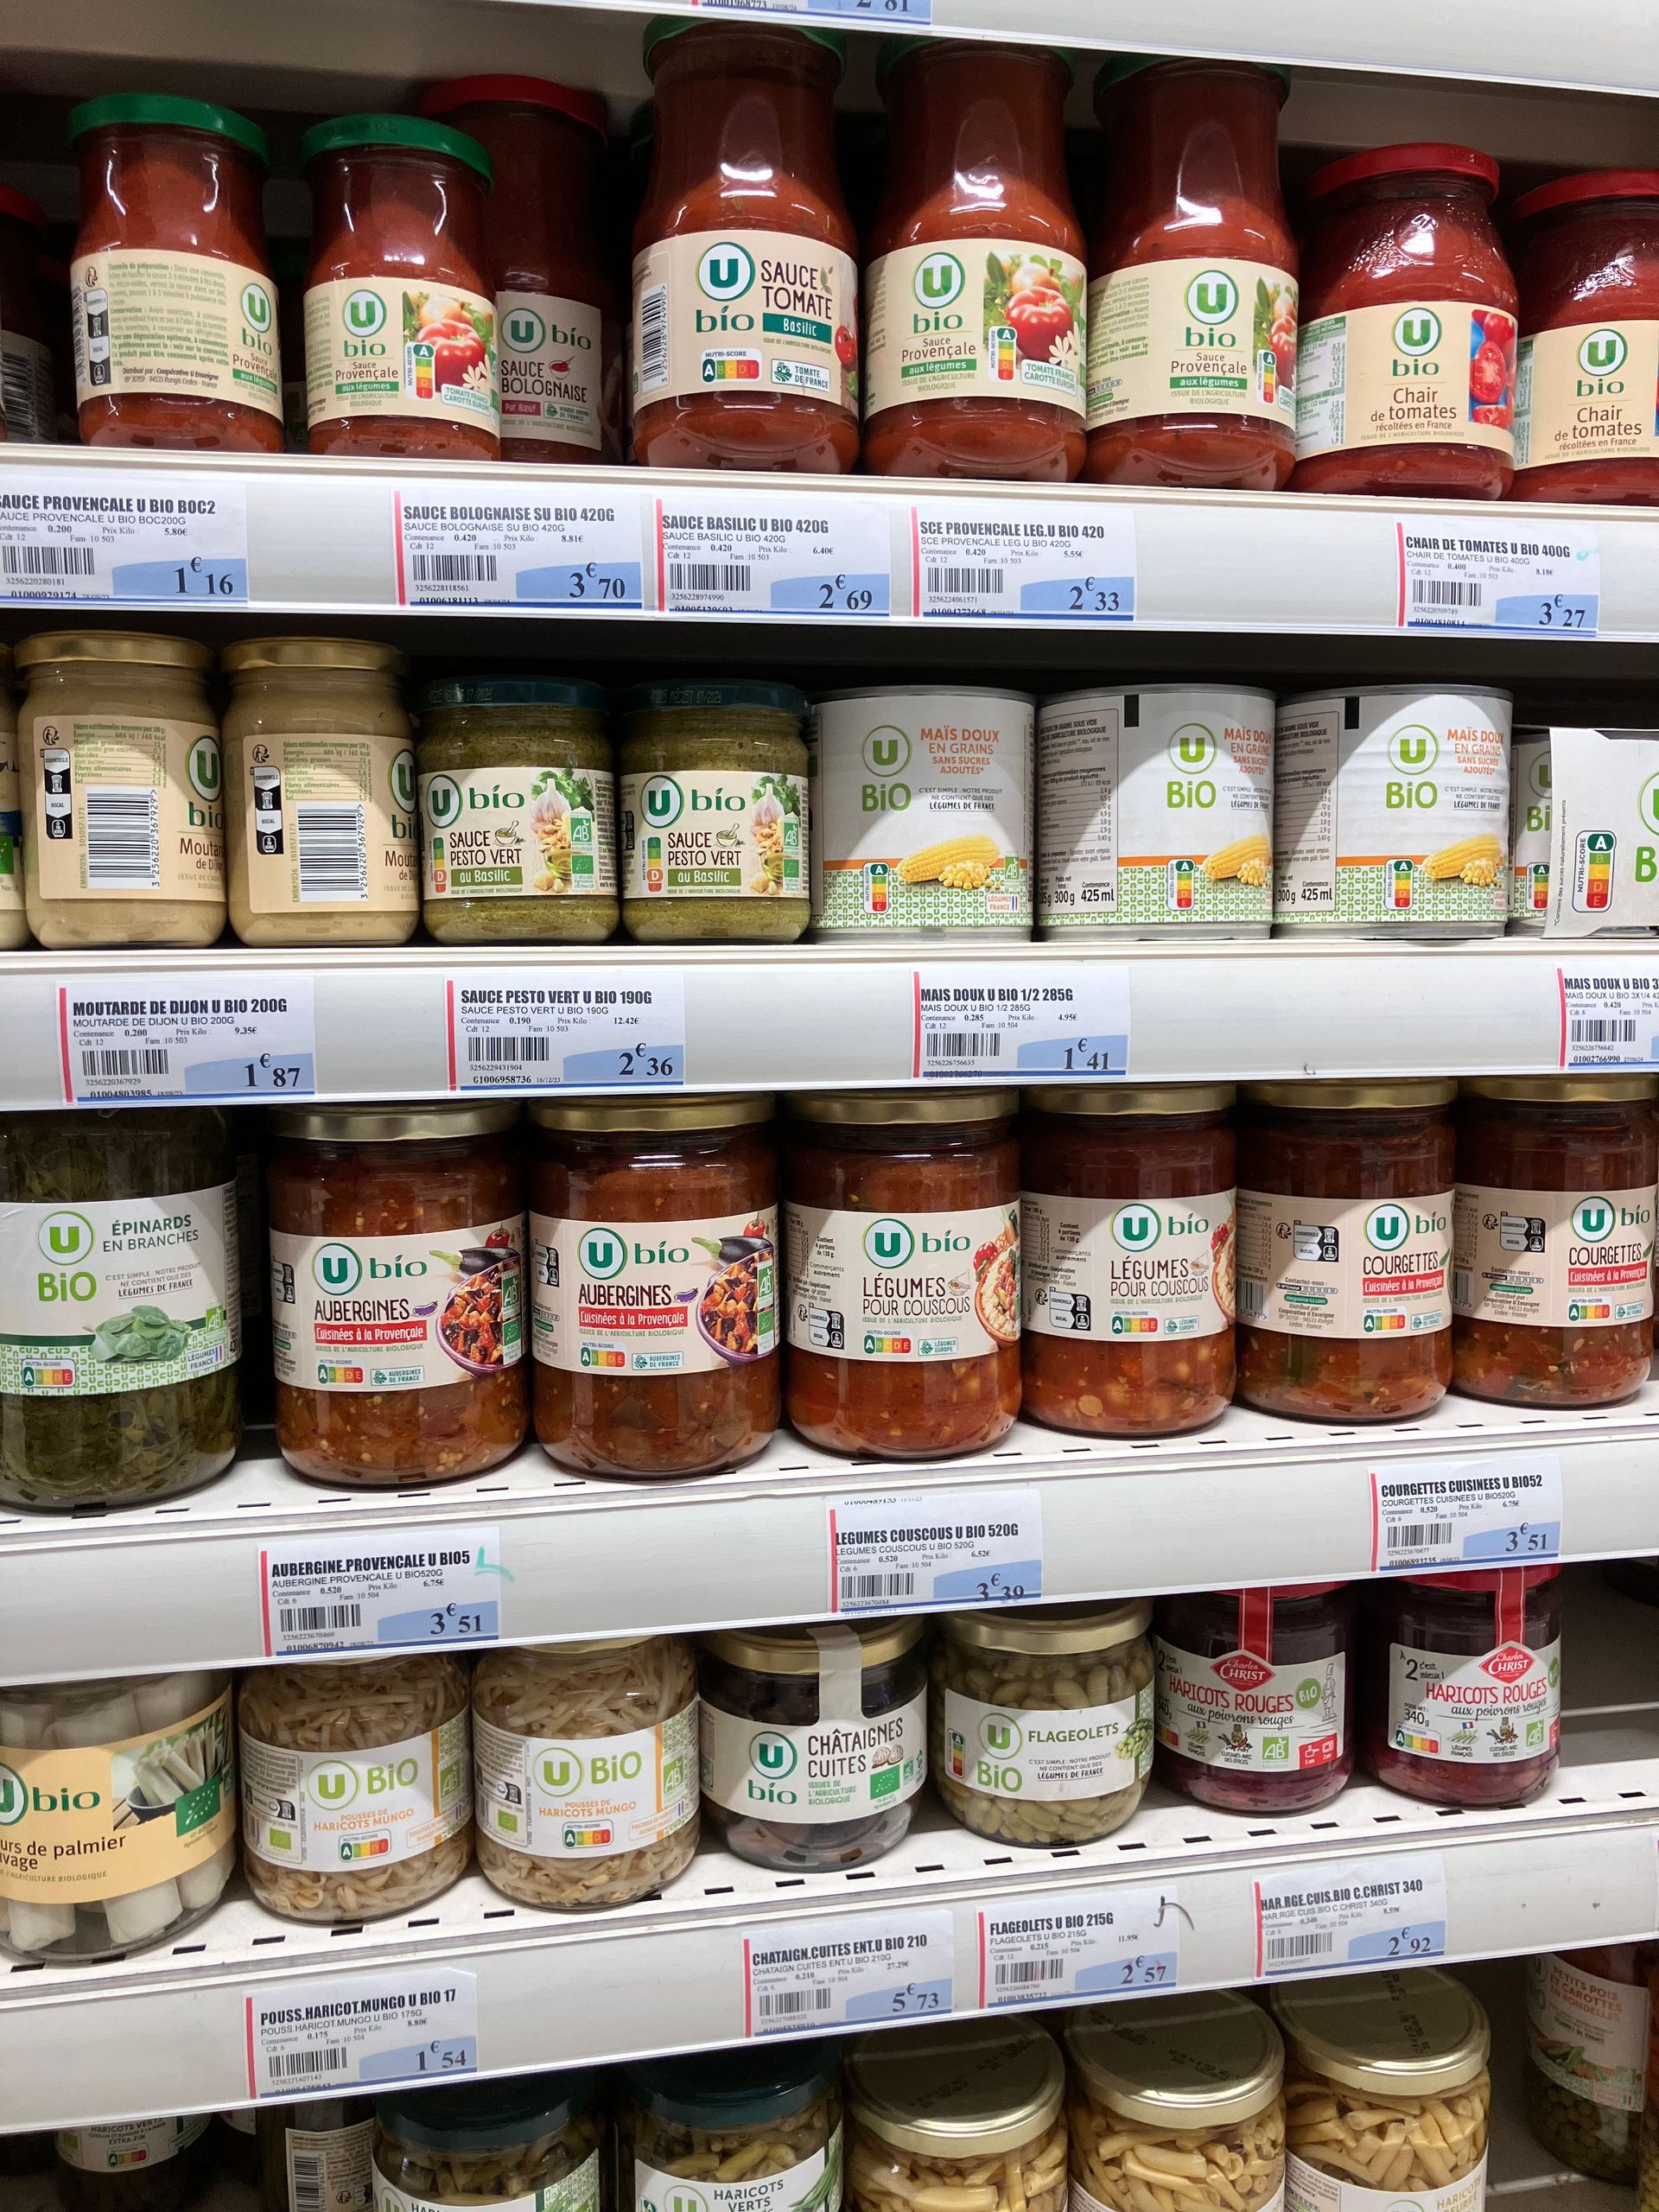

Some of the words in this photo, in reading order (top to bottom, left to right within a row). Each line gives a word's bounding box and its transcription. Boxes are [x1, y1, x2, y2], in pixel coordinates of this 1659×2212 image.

[760, 260, 819, 285] SAUCE
[761, 286, 832, 320] TOMATE
[783, 318, 817, 337] Basilic
[913, 311, 963, 334] bio
[923, 337, 951, 347] Sauce
[902, 342, 976, 362] Provençale
[501, 359, 544, 378] SAUCE
[795, 365, 821, 375] TOMATE
[909, 365, 925, 374] aux
[927, 360, 966, 373] légumes
[501, 378, 588, 403] BOLOGNAISE
[795, 373, 804, 383] DE
[805, 376, 829, 389] FRANCE
[1394, 386, 1438, 404] Chair
[1370, 410, 1385, 422] de
[1389, 404, 1457, 420] tomates
[1376, 421, 1413, 431] récoltées
[1427, 421, 1452, 429] France
[43, 496, 133, 512] PROVENCALE
[137, 499, 146, 512] U
[149, 499, 174, 513] BIO
[178, 499, 216, 514] BOC2
[404, 505, 447, 520] SAUCE
[450, 506, 531, 521] BOLOGNAISE
[534, 507, 551, 521] SU
[555, 507, 577, 522] BIO
[580, 508, 615, 522] 420G
[1406, 537, 1440, 550] CHAIR
[1443, 538, 1456, 551] DE
[1458, 539, 1509, 555] TOMATES
[1511, 543, 1518, 555] U
[1521, 543, 1540, 556] BIO
[1541, 544, 1571, 558] 400G
[919, 725, 957, 741] MAÏS
[962, 728, 1000, 742] DOUX
[929, 743, 946, 754] EN
[950, 743, 994, 755] GRAINS
[932, 756, 957, 765] SANS
[958, 756, 990, 766] SUCRES
[449, 830, 491, 849] SAUCE
[450, 849, 486, 866] PESTO
[489, 849, 522, 864] VERT
[460, 872, 472, 883] au
[474, 870, 511, 883] Basilic
[461, 990, 503, 1004] SAUCE
[505, 989, 545, 1004] PESTO
[548, 990, 581, 1004] VERT
[583, 990, 592, 1004] U
[594, 990, 617, 1004] BIO
[619, 990, 652, 1004] 190G
[920, 988, 950, 1001] MAIS
[953, 988, 985, 1001] DOUX
[988, 988, 995, 1001] U
[998, 988, 1018, 1001] BIO
[1020, 988, 1039, 1001] 1/2
[1042, 988, 1073, 1001] 285G
[73, 1001, 147, 1016] MOUTARDE
[150, 1000, 167, 1015] DE
[169, 999, 208, 1014] DIJON
[212, 1000, 220, 1014] U
[224, 999, 248, 1014] BIO
[251, 998, 288, 1013] 200G
[111, 1214, 192, 1236] ÉPINARDS
[103, 1240, 123, 1253] EN
[127, 1230, 199, 1250] BRANCHES
[1363, 1250, 1439, 1275] COURGETTES
[862, 1273, 945, 1298] LÉGUMES
[314, 1298, 410, 1322] AUBERGINES
[862, 1300, 899, 1316] POUR
[904, 1296, 970, 1316] COUSCOUS
[316, 1327, 354, 1341] Cuisinées
[355, 1327, 363, 1339] à
[365, 1328, 373, 1339] la
[374, 1325, 423, 1341] Provençale
[1382, 1482, 1446, 1497] COURGETTES
[1448, 1478, 1501, 1493] CUISINEES
[1503, 1477, 1510, 1489] U
[1511, 1474, 1543, 1488] BIO52
[835, 1529, 887, 1546] LEGUMES
[890, 1526, 953, 1542] COUSCOUS
[955, 1526, 963, 1539] U
[965, 1525, 985, 1538] BIO
[988, 1522, 1019, 1537] 520G
[271, 1553, 426, 1578] AUBERGINE.PROVENCALE
[428, 1553, 437, 1567] U
[439, 1550, 471, 1565] BIO5
[1227, 1658, 1258, 1670] Charles
[1220, 1668, 1266, 1681] CHRIST
[1169, 1675, 1230, 1707] HARICOTS
[1234, 1694, 1294, 1713] ROUGES
[1299, 1684, 1317, 1701] BIO
[1187, 1703, 1206, 1717] aux
[1209, 1709, 1256, 1726] poivrons
[1257, 1714, 1294, 1731] rouges
[807, 1717, 904, 1757] CHÂTAIGNES
[1028, 1722, 1119, 1744] FLAGEOLETS
[808, 1754, 867, 1778] CUITES
[1037, 1770, 1068, 1781] LÉGUMES
[1070, 1770, 1079, 1779] DE
[1080, 1767, 1104, 1778] FRANCE
[32, 1786, 100, 1812] bio
[809, 1786, 857, 1796] L'AGRICULTURE
[809, 1795, 851, 1805] BIOLOGIQUE
[538, 1805, 593, 1818] HARICOTS
[596, 1802, 637, 1815] MUNGO
[565, 1799, 599, 1809] POUSSES
[601, 1799, 611, 1808] DE
[26, 1841, 48, 1857] de
[54, 1834, 126, 1859] palmier
[6, 1871, 56, 1883] L'AGRICULTURE
[59, 1871, 107, 1883] BIOLOGIQUE
[1261, 1888, 1351, 1911] HAR.RGE.CUIS.BIO
[1354, 1882, 1401, 1900] C.CHRIST
[1403, 1878, 1423, 1892] 340
[990, 1917, 1053, 1936] FLAGEOLETS
[1055, 1916, 1063, 1929] U
[1065, 1915, 1084, 1929] BIO
[1086, 1911, 1114, 1927] 215G
[753, 1942, 851, 1966] CHATAIGN.CUITES
[853, 1939, 883, 1954] ENT.U
[885, 1936, 904, 1951] BIO
[906, 1934, 927, 1948] 210
[260, 1995, 406, 2025] POUSS.HARICOT.MUNGO
[409, 1993, 416, 2007] U
[420, 1991, 442, 2005] BIO
[443, 1988, 456, 2002] 17
[714, 2179, 784, 2201] HARICOTS
[728, 2196, 771, 2212] VERTS
